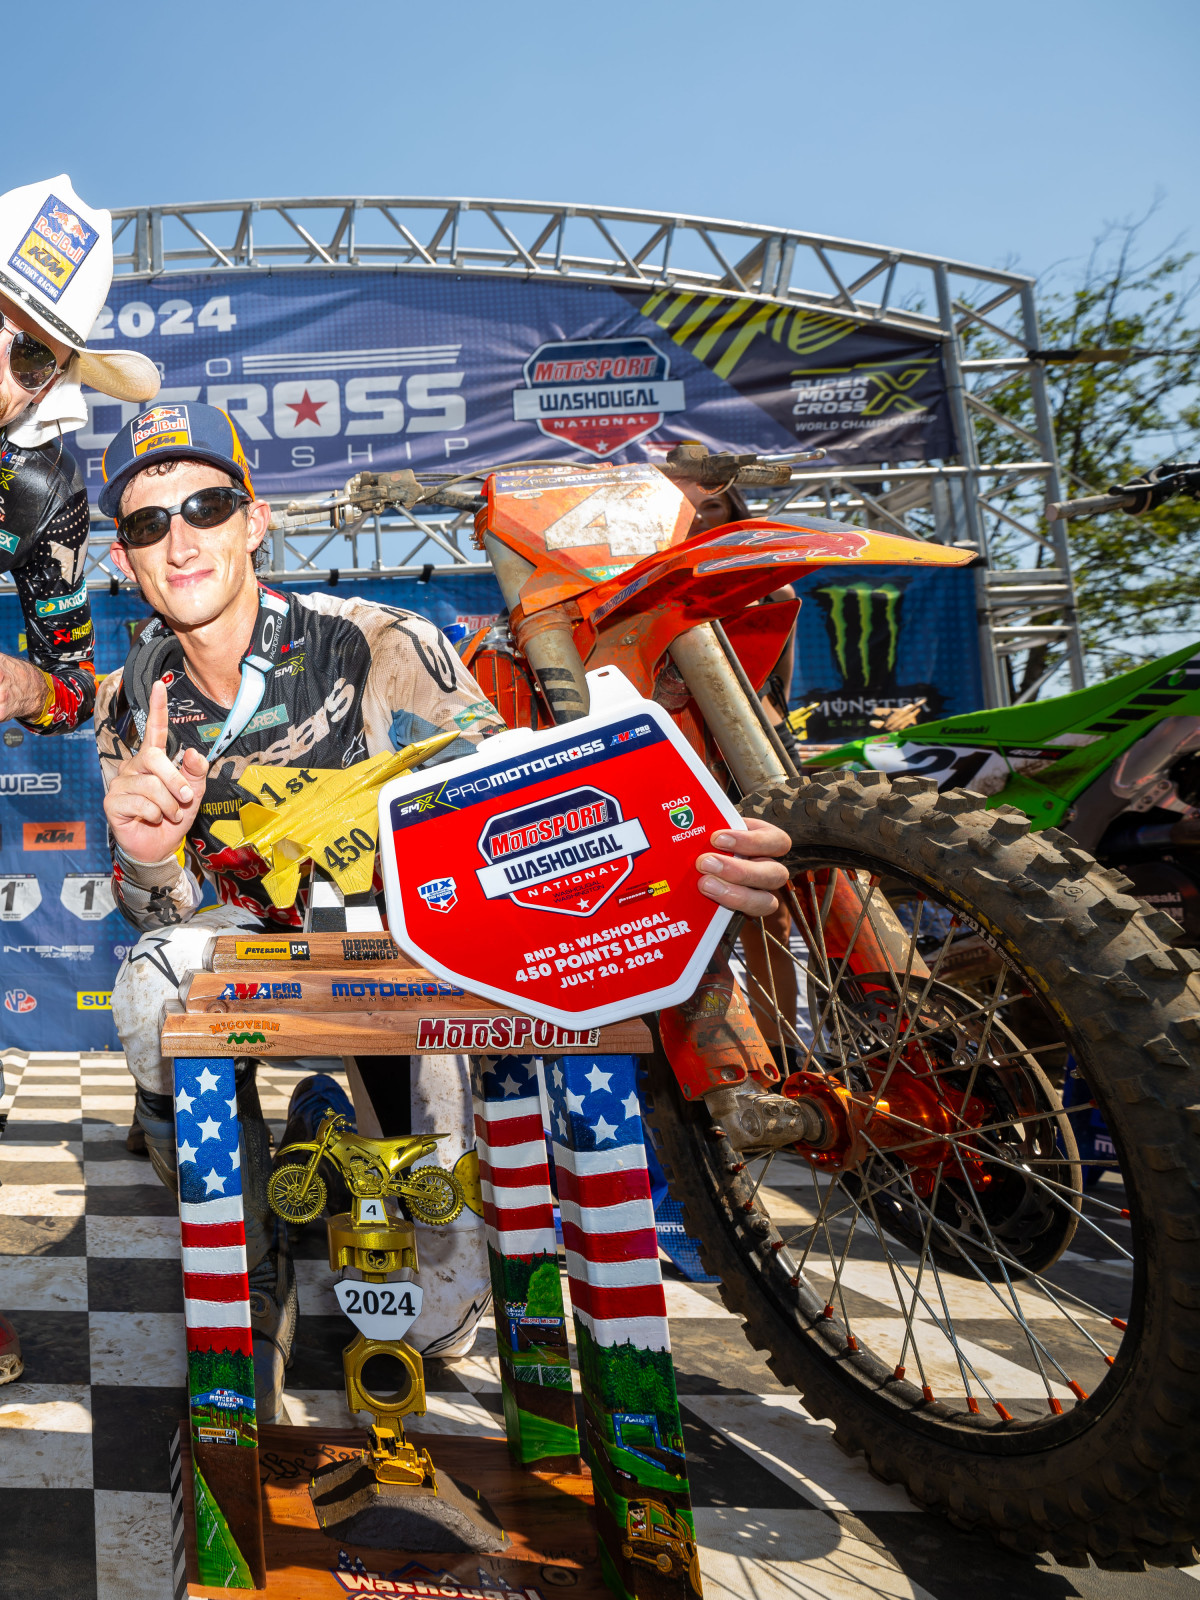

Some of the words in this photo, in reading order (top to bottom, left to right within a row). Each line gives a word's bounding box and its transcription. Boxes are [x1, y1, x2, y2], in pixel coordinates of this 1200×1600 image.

[34, 215, 64, 245] Red
[57, 235, 86, 264] Bull
[27, 246, 65, 278] KTM
[12, 256, 37, 280] FACTORY
[36, 276, 59, 297] RACING
[87, 296, 236, 340] 2024
[791, 376, 869, 391] SUPER
[539, 389, 659, 411] WASHOUGAL
[798, 388, 867, 402] MOTO
[792, 401, 868, 415] CROSS
[134, 423, 158, 444] Red
[160, 418, 187, 431] Bull
[554, 417, 648, 429] NATIONAL
[795, 421, 839, 432] WORLD
[841, 415, 938, 429] CHAMPIONSHIP
[147, 435, 176, 451] KTM
[544, 484, 664, 557] 4
[940, 724, 990, 735] Kawasaki
[400, 795, 436, 816] SMX
[610, 729, 637, 747] AMA
[635, 724, 651, 734] PRO
[887, 749, 993, 794] 21
[259, 768, 318, 807] 1st
[662, 795, 691, 810] ROAD
[677, 813, 690, 826] 2
[35, 829, 75, 844] KTM
[672, 825, 706, 843] RECOVERY
[323, 827, 376, 872] 450
[504, 834, 623, 884] WASHOUGAL
[421, 879, 452, 895] MX
[528, 864, 619, 897] NATIONAL
[553, 880, 601, 898] WASHOUGAL
[553, 884, 605, 903] WASHINGTON
[523, 947, 556, 964] RND
[559, 943, 574, 953] 8:
[575, 912, 670, 948] WASHOUGAL
[3, 945, 94, 953] INTENSE
[292, 945, 307, 954] CAT
[515, 963, 552, 982] 450
[554, 942, 623, 972] POINTS
[624, 920, 691, 952] LEADER
[560, 969, 595, 989] JULY
[598, 963, 624, 978] 20,
[625, 949, 664, 969] 2024
[6, 989, 27, 1011] VP
[216, 983, 271, 1000] AMA
[272, 983, 302, 993] PRO
[332, 983, 465, 997] MOTOCROSS
[365, 1205, 377, 1216] 4
[345, 1289, 416, 1316] 2024
[336, 1570, 543, 1600] Washougal
